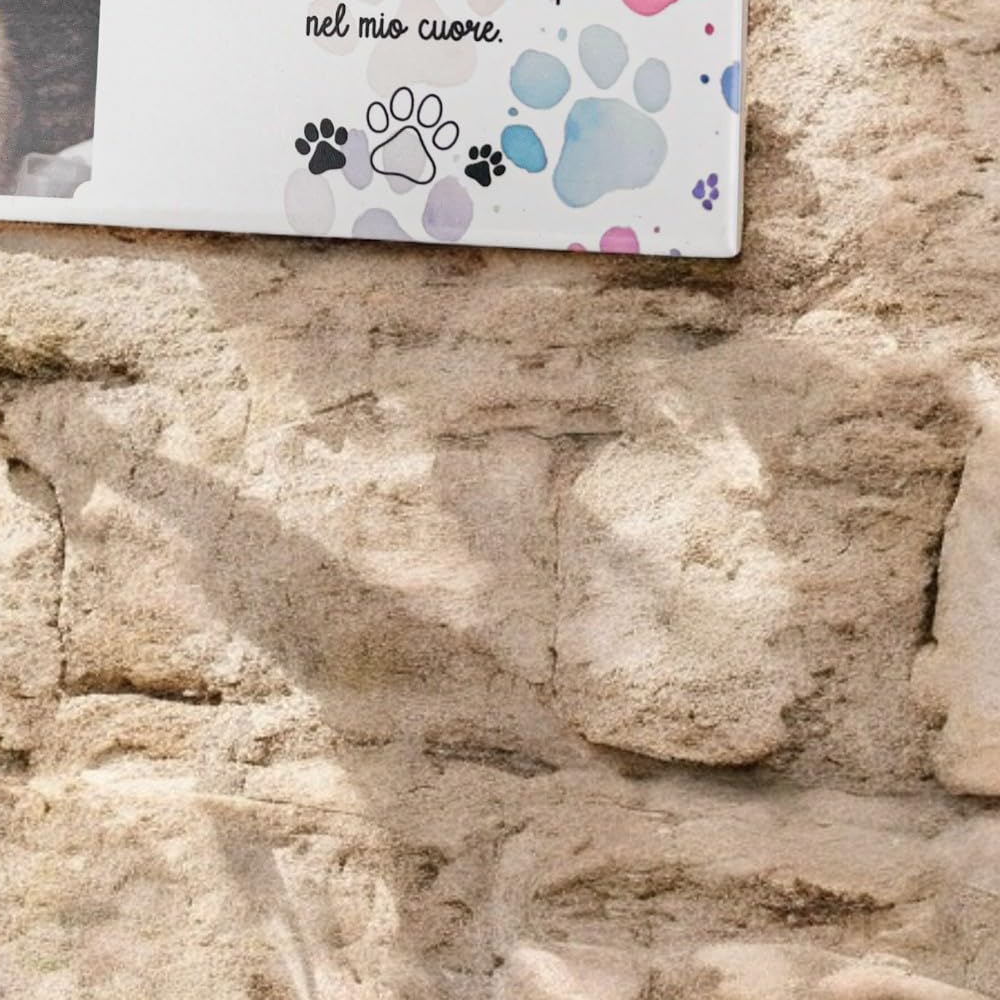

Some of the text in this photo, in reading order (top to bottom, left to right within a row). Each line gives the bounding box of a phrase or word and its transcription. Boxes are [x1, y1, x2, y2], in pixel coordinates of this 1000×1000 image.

[305, 2, 504, 43] nel mio cuore.
